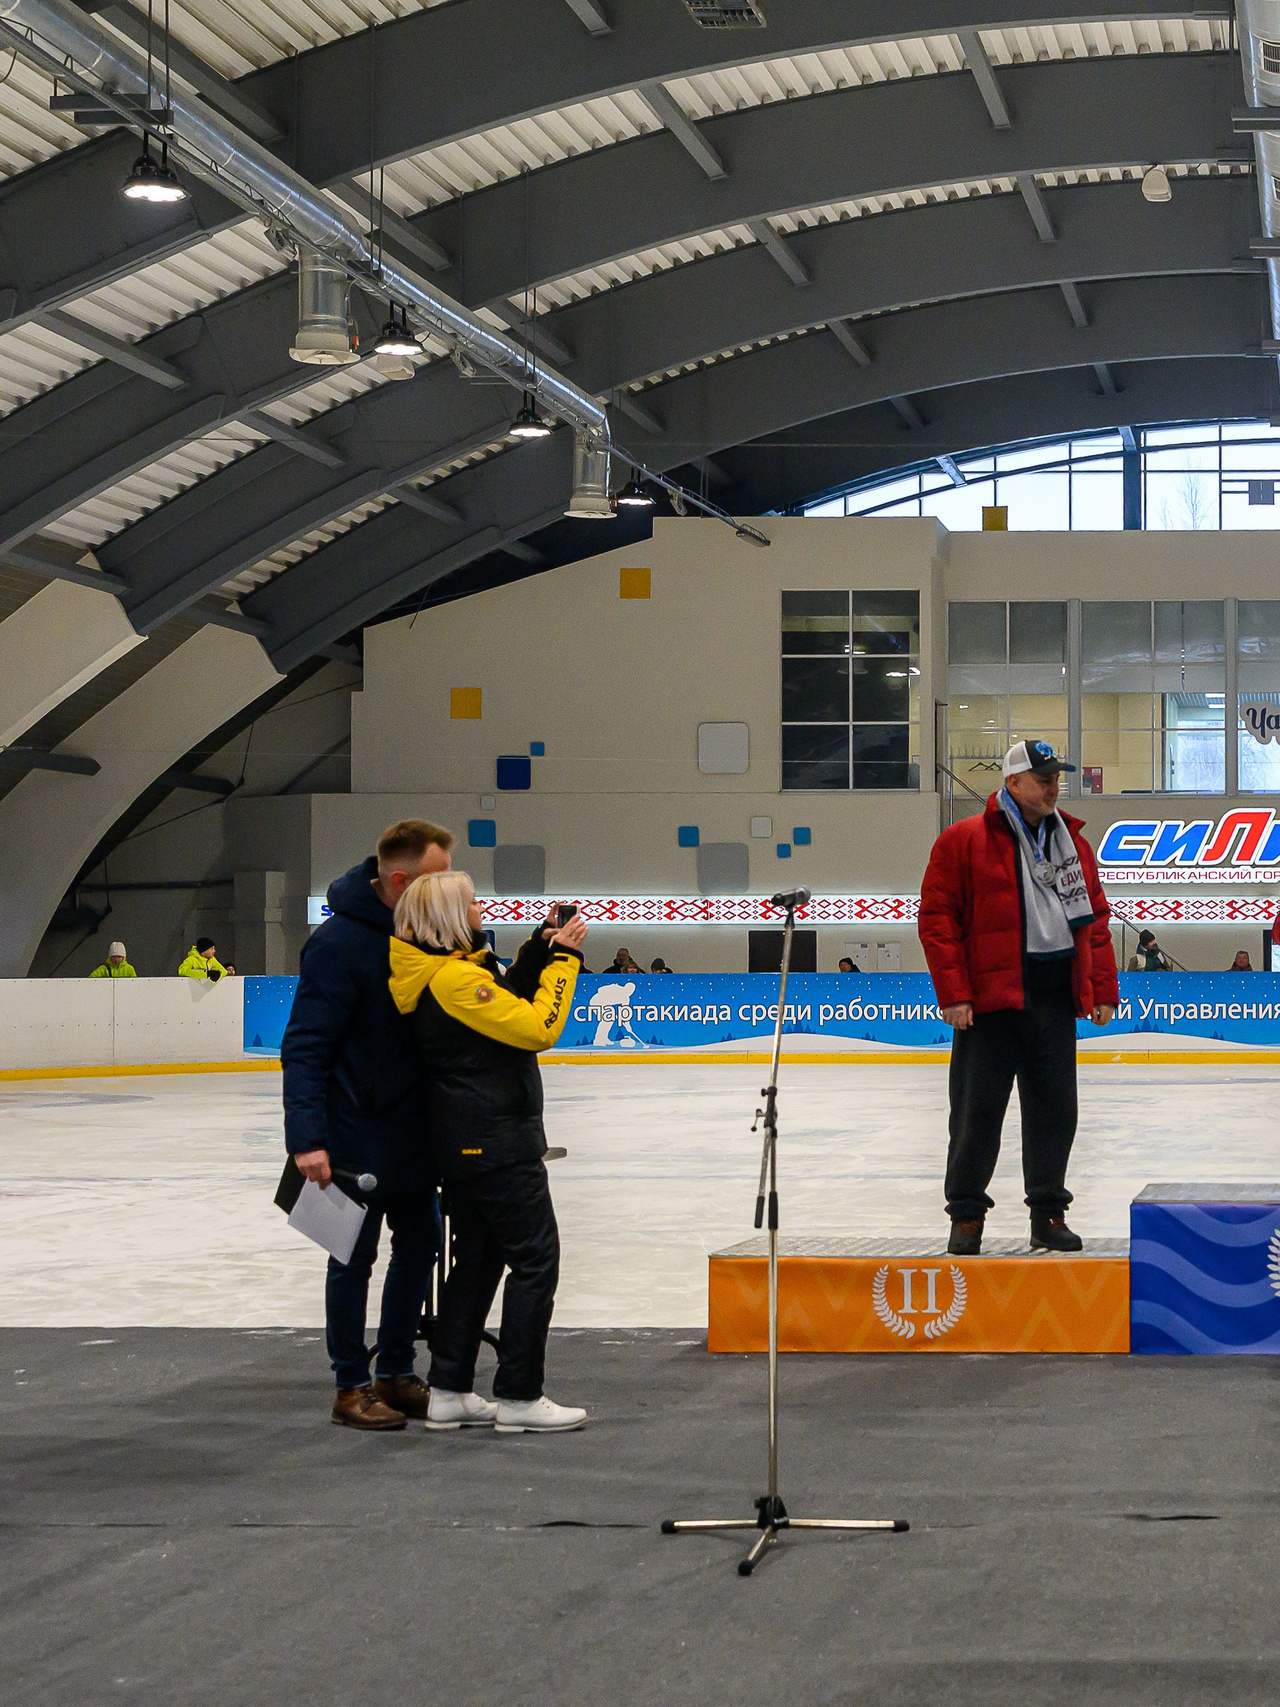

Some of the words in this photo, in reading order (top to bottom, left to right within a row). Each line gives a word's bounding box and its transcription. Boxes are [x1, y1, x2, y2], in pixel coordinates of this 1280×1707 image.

[1098, 868, 1252, 880] РЕСПУБЛИКАНСКИЙ
[573, 1003, 732, 1027] спартакиада
[738, 1003, 812, 1027] среди
[897, 1268, 942, 1313] II
